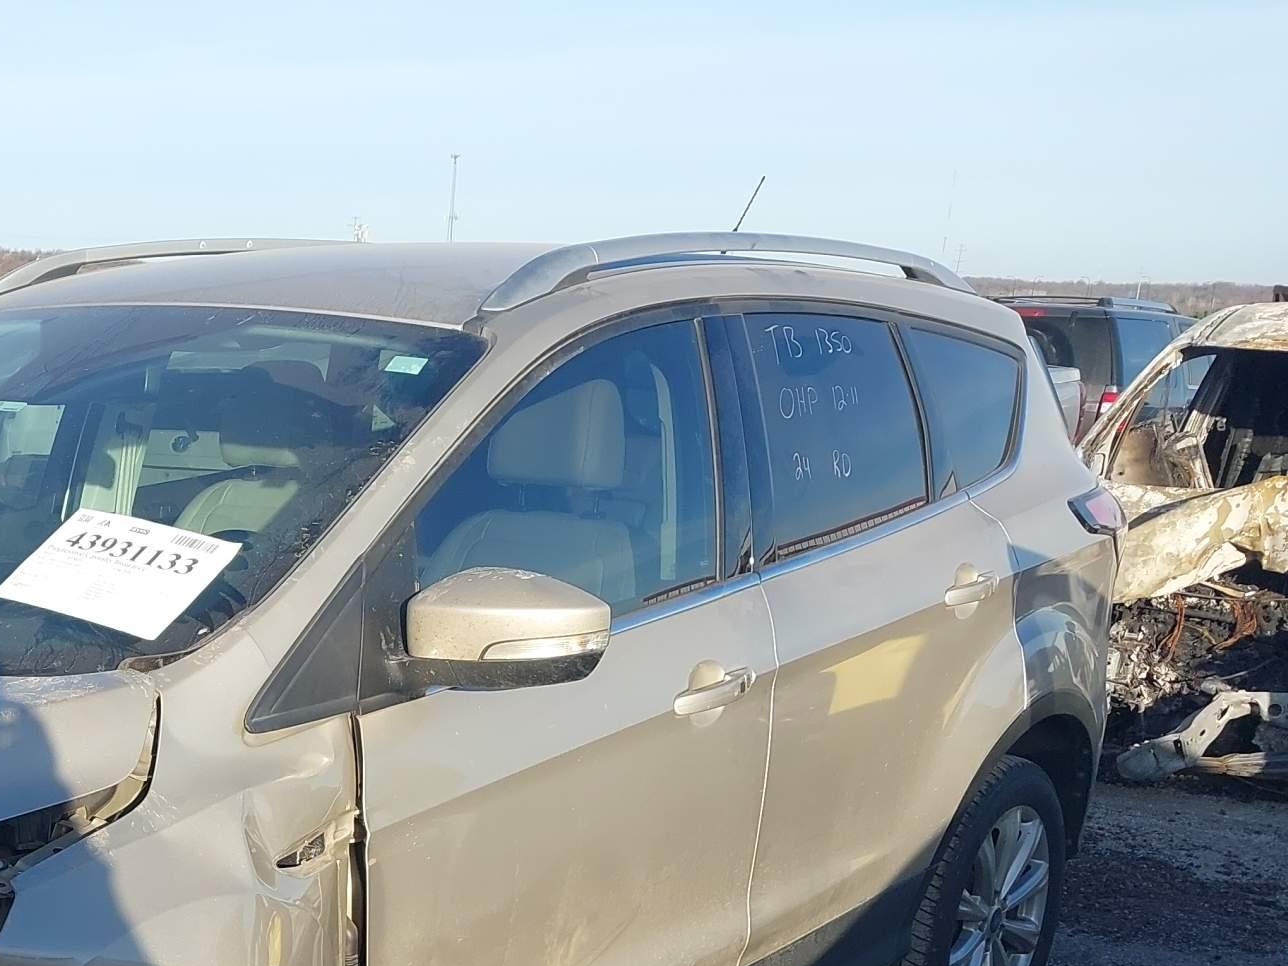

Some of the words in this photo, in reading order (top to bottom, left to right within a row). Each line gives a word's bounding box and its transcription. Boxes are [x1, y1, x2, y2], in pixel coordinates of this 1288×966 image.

[764, 324, 803, 366] TB
[779, 385, 818, 420] OHP
[792, 452, 812, 481] 24
[65, 530, 200, 575] 43931133
